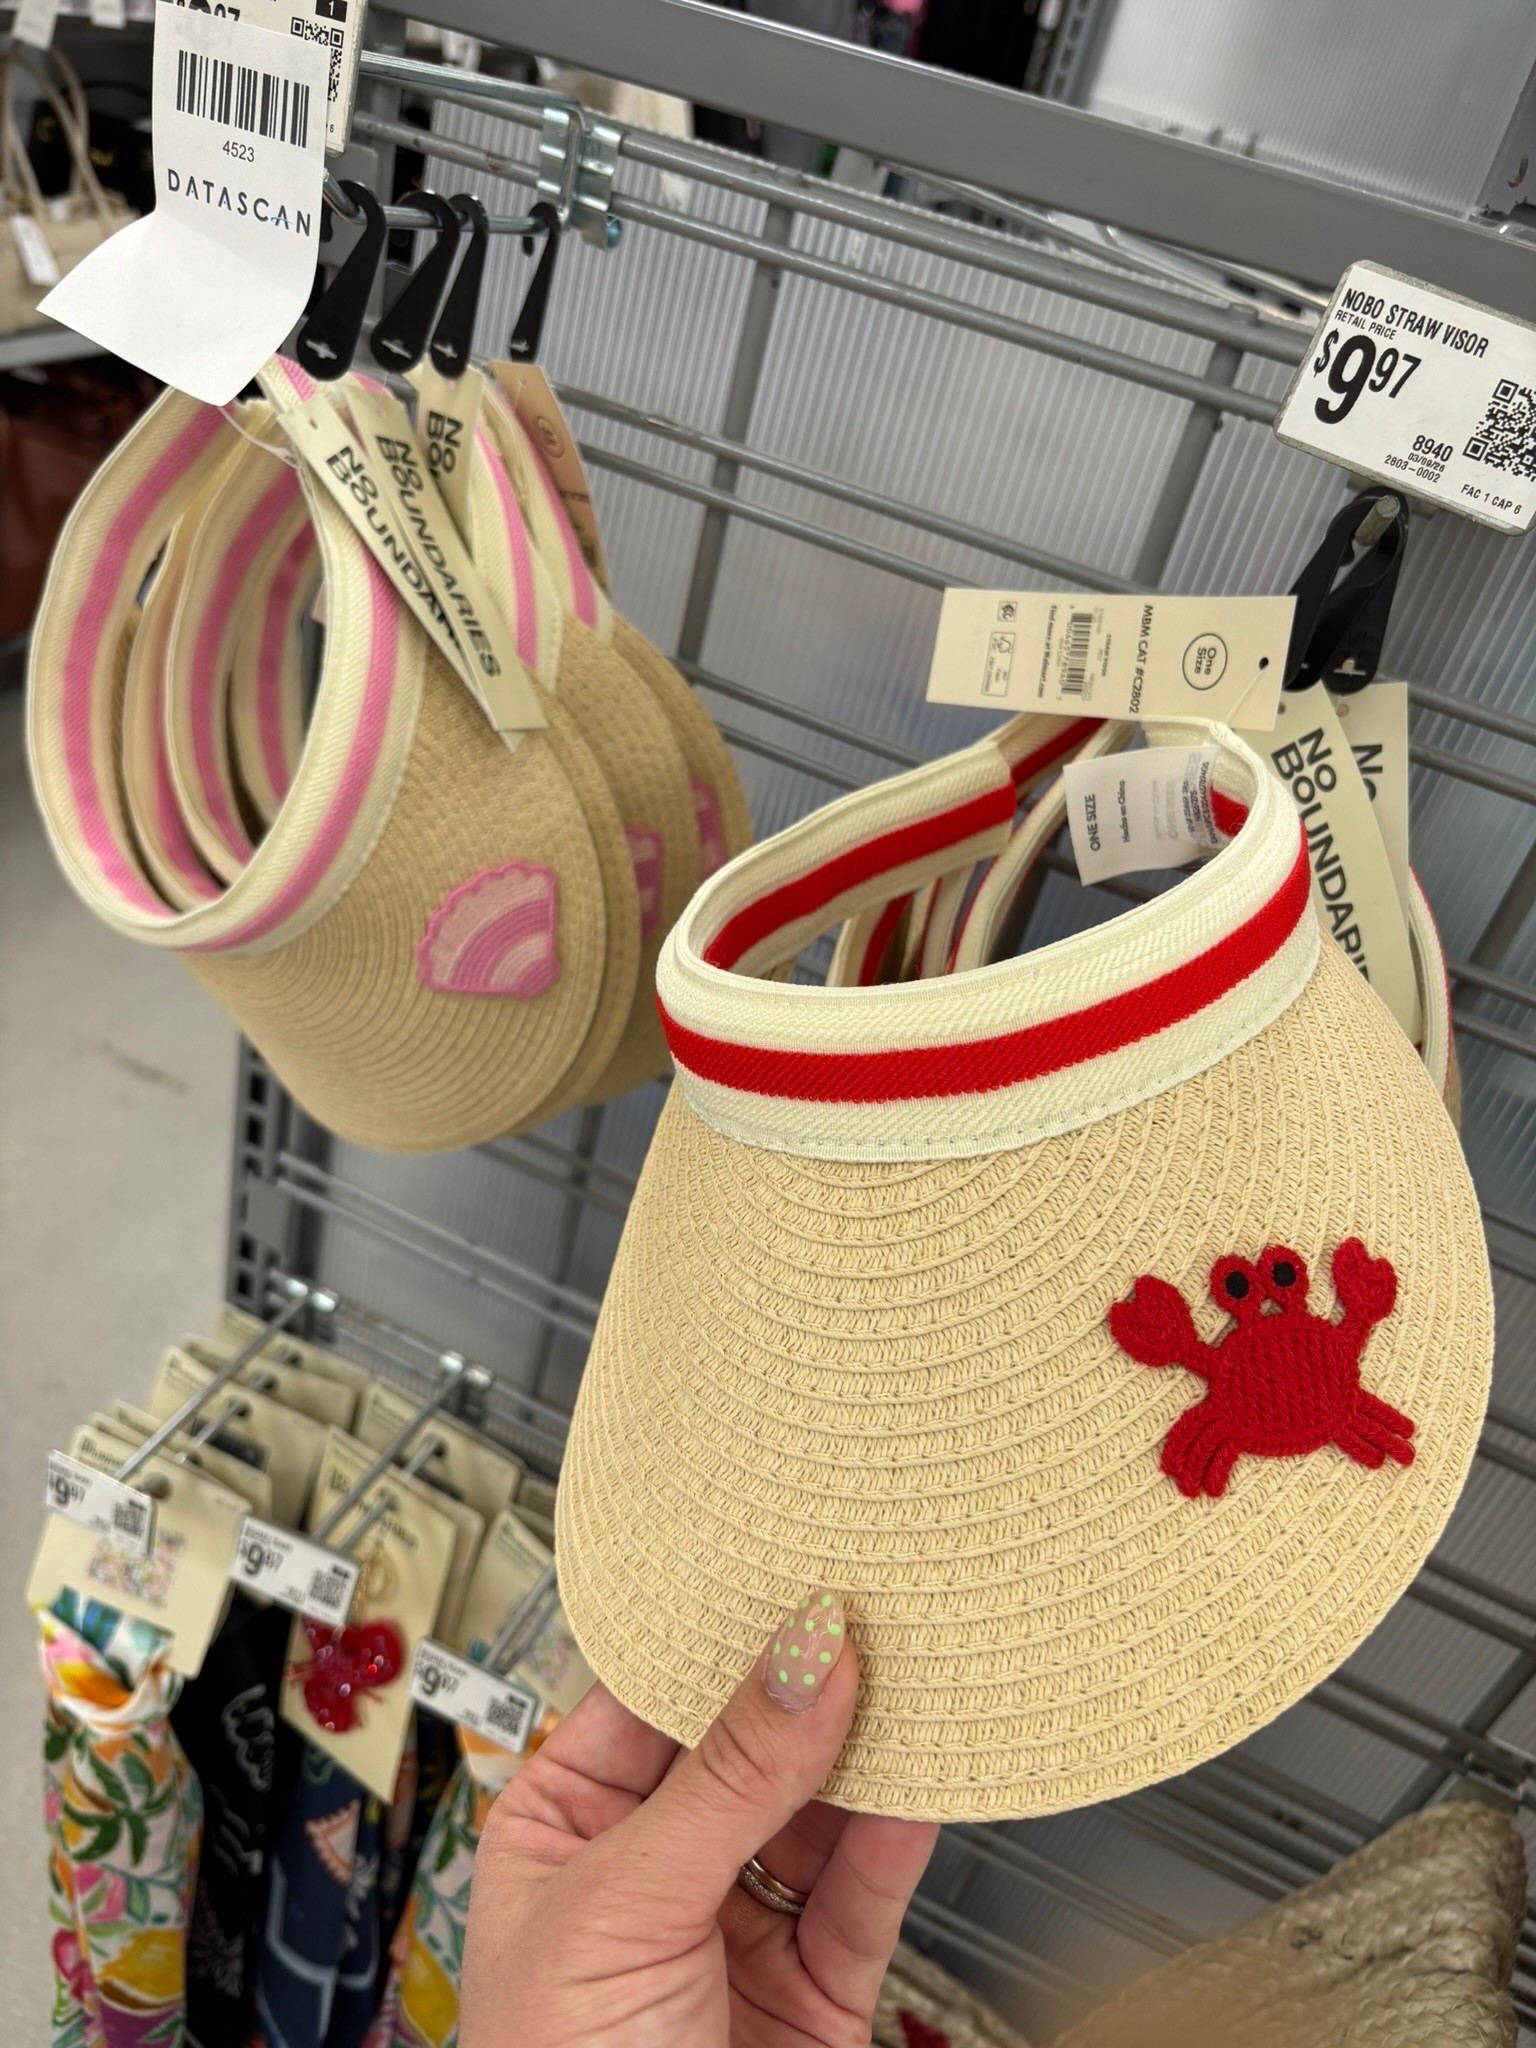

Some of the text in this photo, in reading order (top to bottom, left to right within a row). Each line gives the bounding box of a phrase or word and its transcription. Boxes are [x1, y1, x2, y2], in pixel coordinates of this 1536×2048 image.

[222, 140, 255, 163] 4523
[167, 168, 311, 237] DATASCAN
[1334, 309, 1397, 340] RETAIL PRICE
[1341, 288, 1489, 358] NOBO STRAW VISOR
[1412, 435, 1454, 462] 8940
[1461, 484, 1522, 515] FAC 1 CAP 6
[375, 435, 501, 678] BOUNDARIES
[1129, 604, 1153, 714] MBM CAT #C2802
[1194, 647, 1207, 675] Size
[1204, 647, 1217, 676] One
[1298, 727, 1337, 793] NO
[1118, 780, 1126, 805] China
[1084, 793, 1101, 852] ONE SIZE
